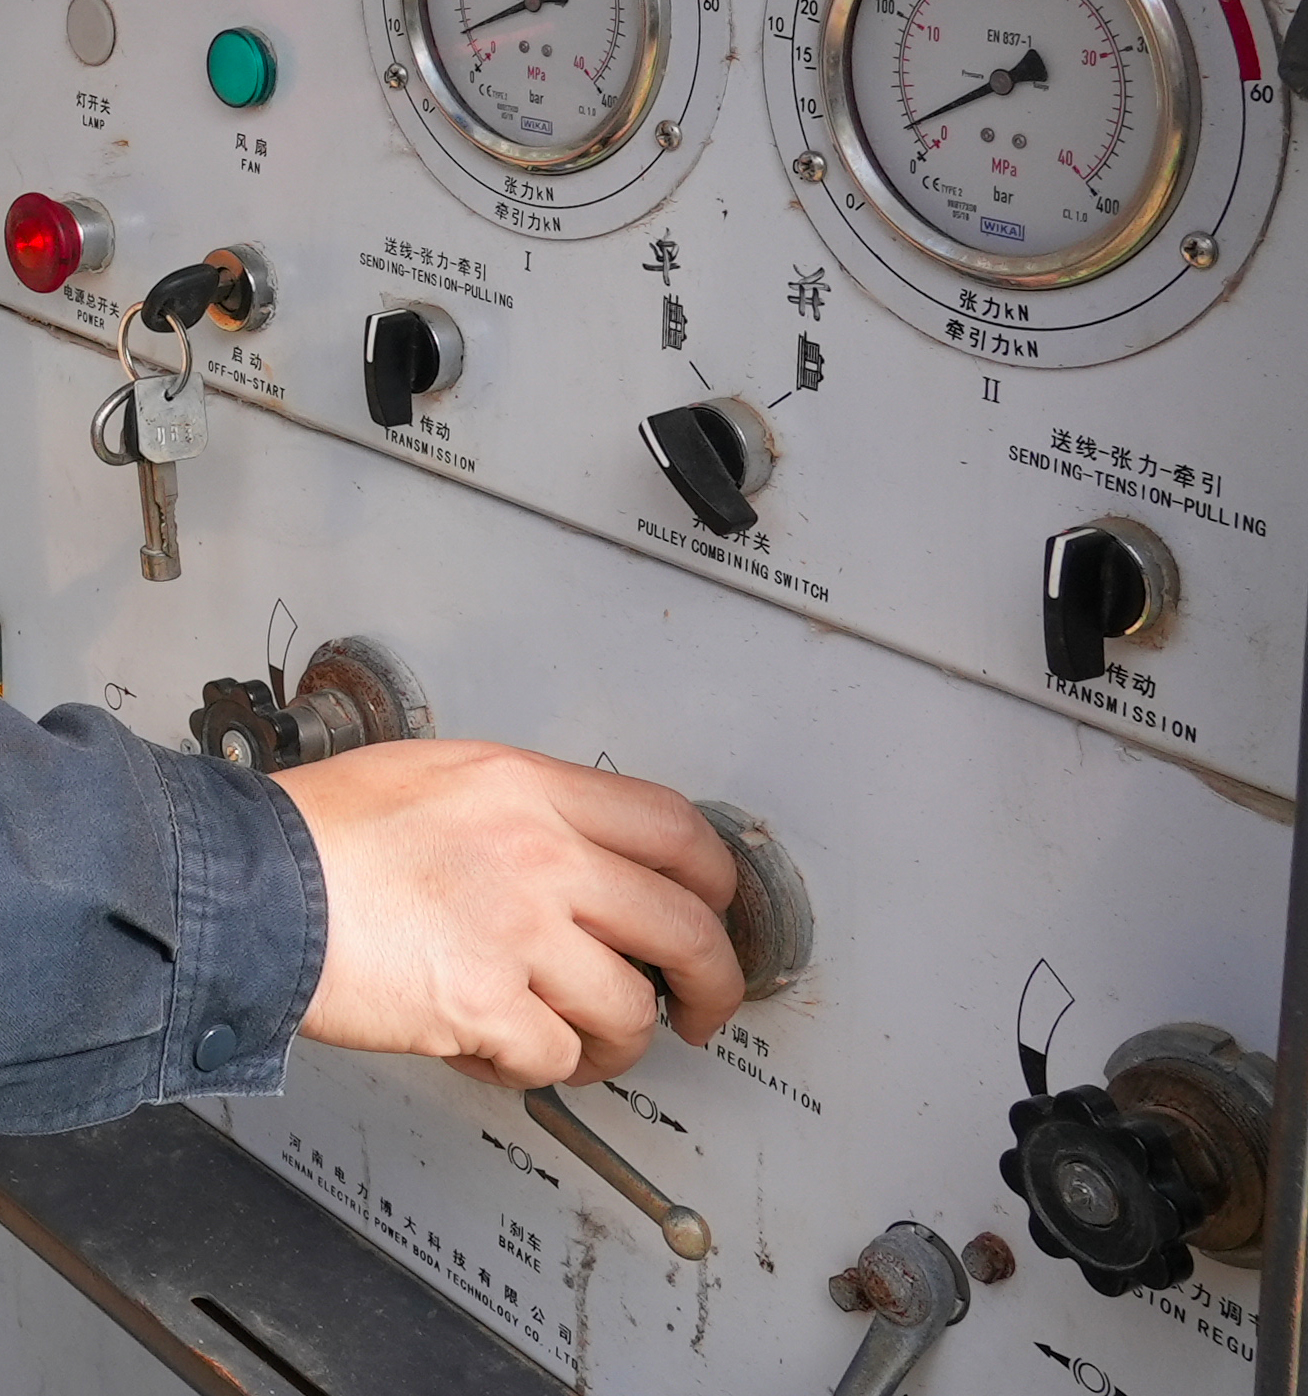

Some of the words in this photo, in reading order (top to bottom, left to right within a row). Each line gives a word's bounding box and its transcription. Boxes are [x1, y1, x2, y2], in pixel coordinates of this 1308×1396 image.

[800, 0, 819, 16] 20
[388, 19, 402, 33] 10
[768, 17, 785, 33] 10
[927, 26, 940, 42] 10
[987, 29, 1000, 44] EN
[1002, 31, 1033, 48] 837-1
[573, 56, 585, 70] 40
[795, 46, 813, 62] 15
[1082, 50, 1097, 66] 30
[527, 65, 547, 81] MPa
[76, 90, 111, 115] 灯开关
[529, 89, 545, 105] bar
[1250, 86, 1274, 103] 60
[799, 98, 817, 114] 10
[82, 113, 106, 131] LAMP
[522, 117, 552, 134] WIKA
[940, 125, 948, 140] 0
[235, 132, 269, 158] 风扇
[240, 158, 261, 175] FAN
[909, 159, 917, 174] 0
[991, 157, 1018, 177] MPa
[1058, 149, 1074, 166] 40
[504, 176, 555, 202] 张力kN
[993, 186, 1014, 205] bar
[845, 193, 855, 210] 0
[1096, 196, 1120, 216] 400
[494, 203, 562, 233] 牵引力kN
[1063, 208, 1074, 220] CL
[1075, 209, 1088, 223] 1.0
[982, 218, 1022, 238] WIKA
[383, 236, 488, 282] 送线-张力-牵引
[359, 251, 515, 310] SENDING-TENSION-PULLING
[63, 283, 121, 320] 电源总开关
[959, 288, 1030, 323] 张力kN
[76, 309, 106, 331] POWER
[945, 319, 1039, 360] 牵引力kN
[230, 345, 263, 372] 启动
[208, 358, 287, 400] OFF-ON-START
[384, 427, 476, 473] TRANSMISSION
[1050, 427, 1223, 498] 送线-张力-牵引
[1008, 444, 1267, 538] SENDING-TENSION-PULLING
[692, 517, 771, 555] 开关
[637, 518, 687, 548] PULLEY
[691, 539, 769, 580] COMBINING
[774, 570, 829, 603] SWITCH
[1044, 672, 1198, 743] TRANSMISSION
[716, 1044, 822, 1116] REGULATION
[281, 1150, 314, 1182] HENAN
[316, 1176, 370, 1221] ELECTRIC
[373, 1217, 409, 1249] POWER
[412, 1242, 441, 1273] BODA
[445, 1267, 519, 1329] TECHNOLOGY
[287, 1131, 573, 1346] 河南电力博大科技有限公司
[498, 1234, 542, 1274] BRAKE
